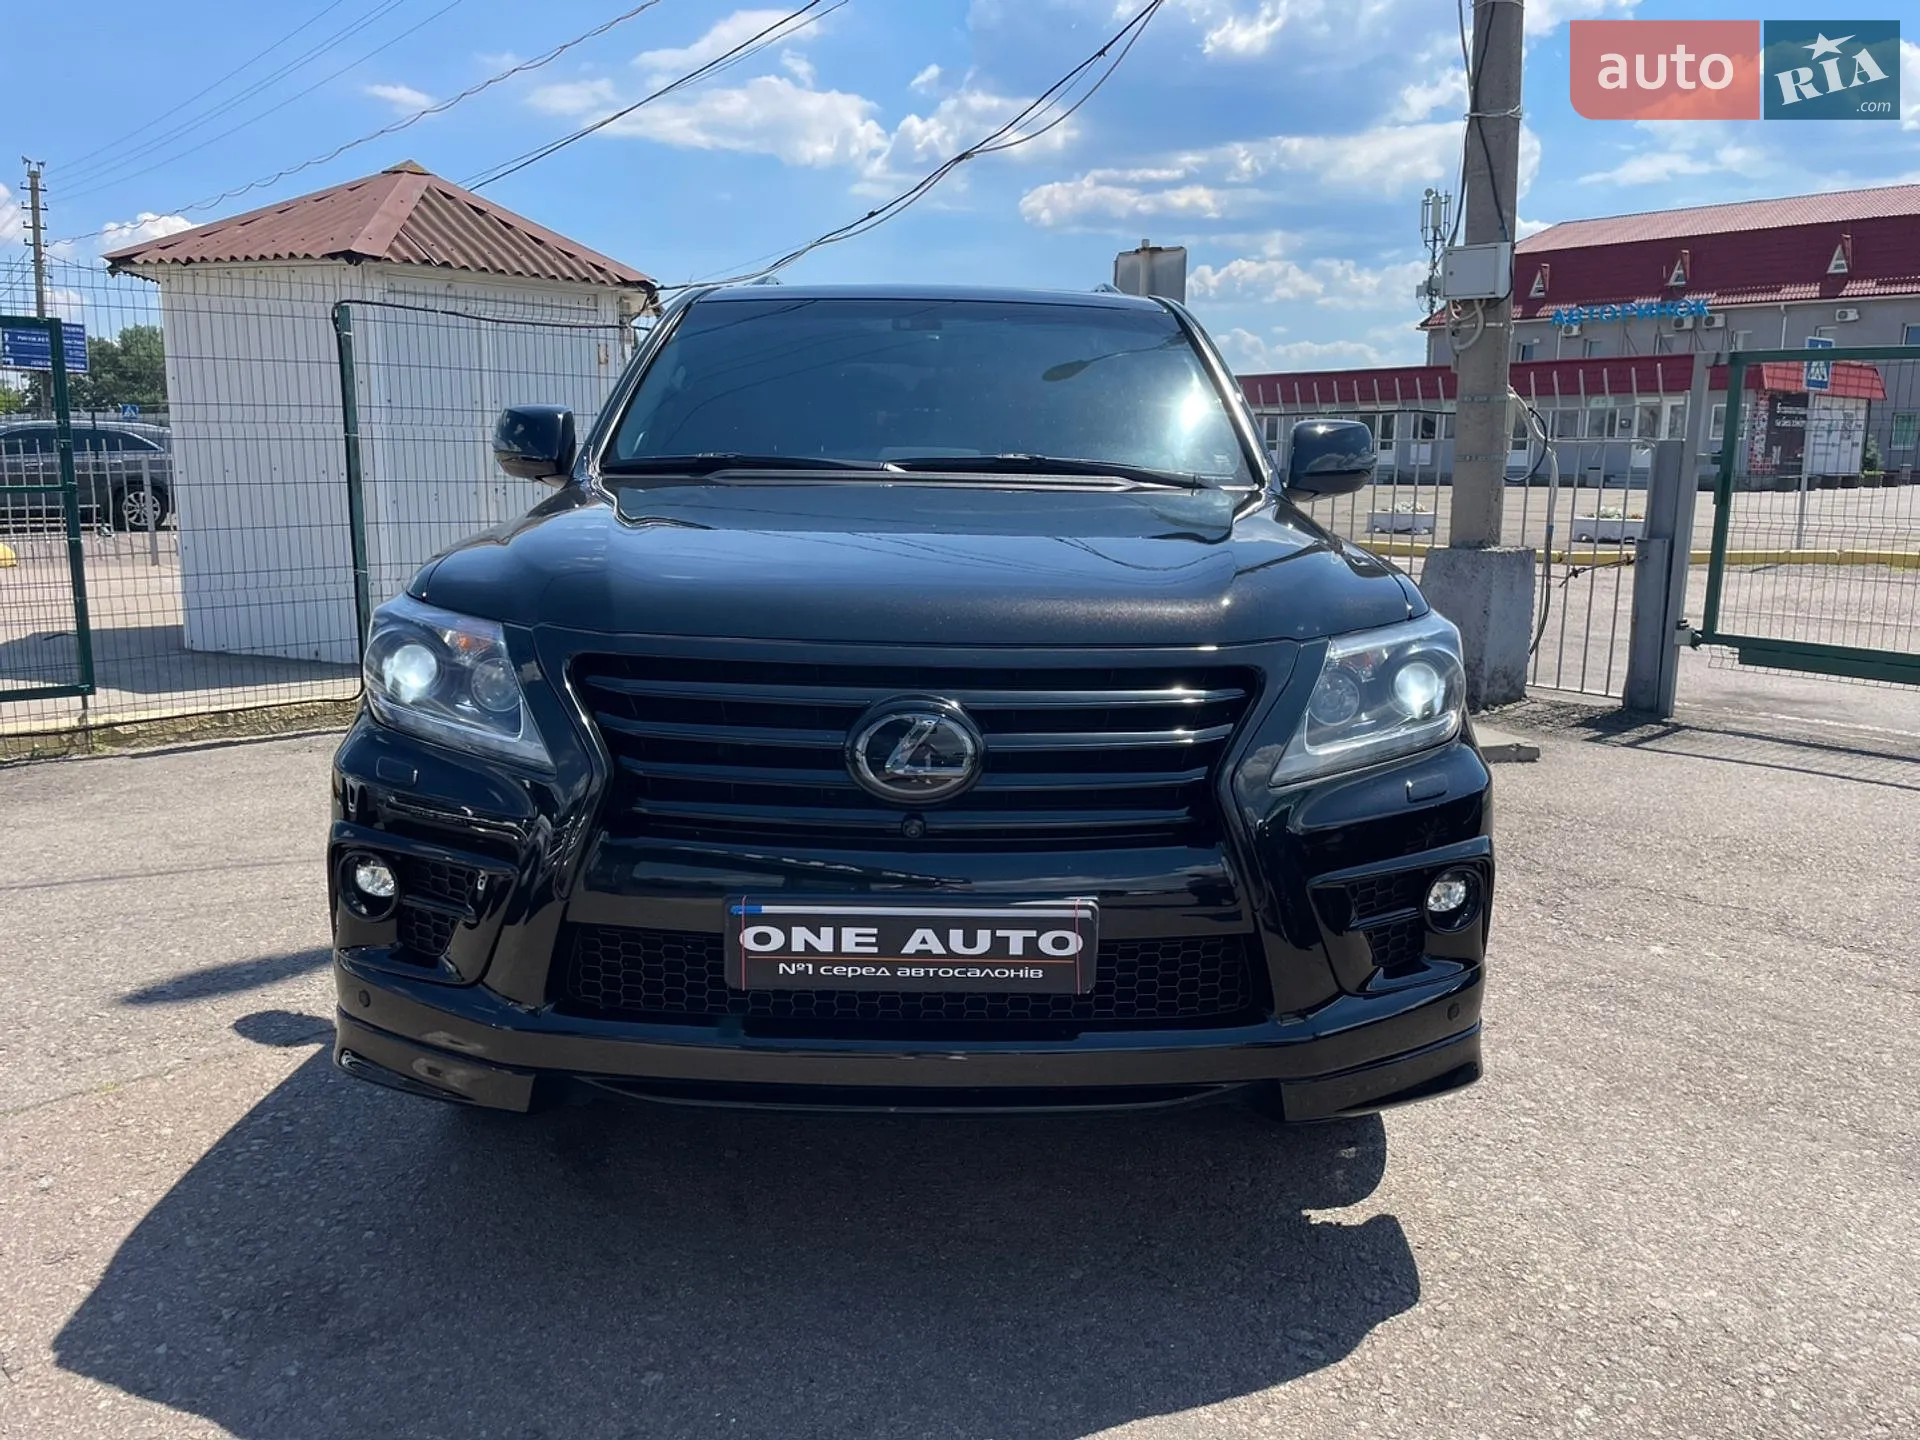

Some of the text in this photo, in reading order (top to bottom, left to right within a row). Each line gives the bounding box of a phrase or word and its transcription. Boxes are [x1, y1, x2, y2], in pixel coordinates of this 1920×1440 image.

[1551, 299, 1709, 326] АВТОРИНОК
[739, 926, 1084, 956] ONE AUTO
[820, 965, 891, 978] серед
[897, 967, 1043, 979] автосалонів
